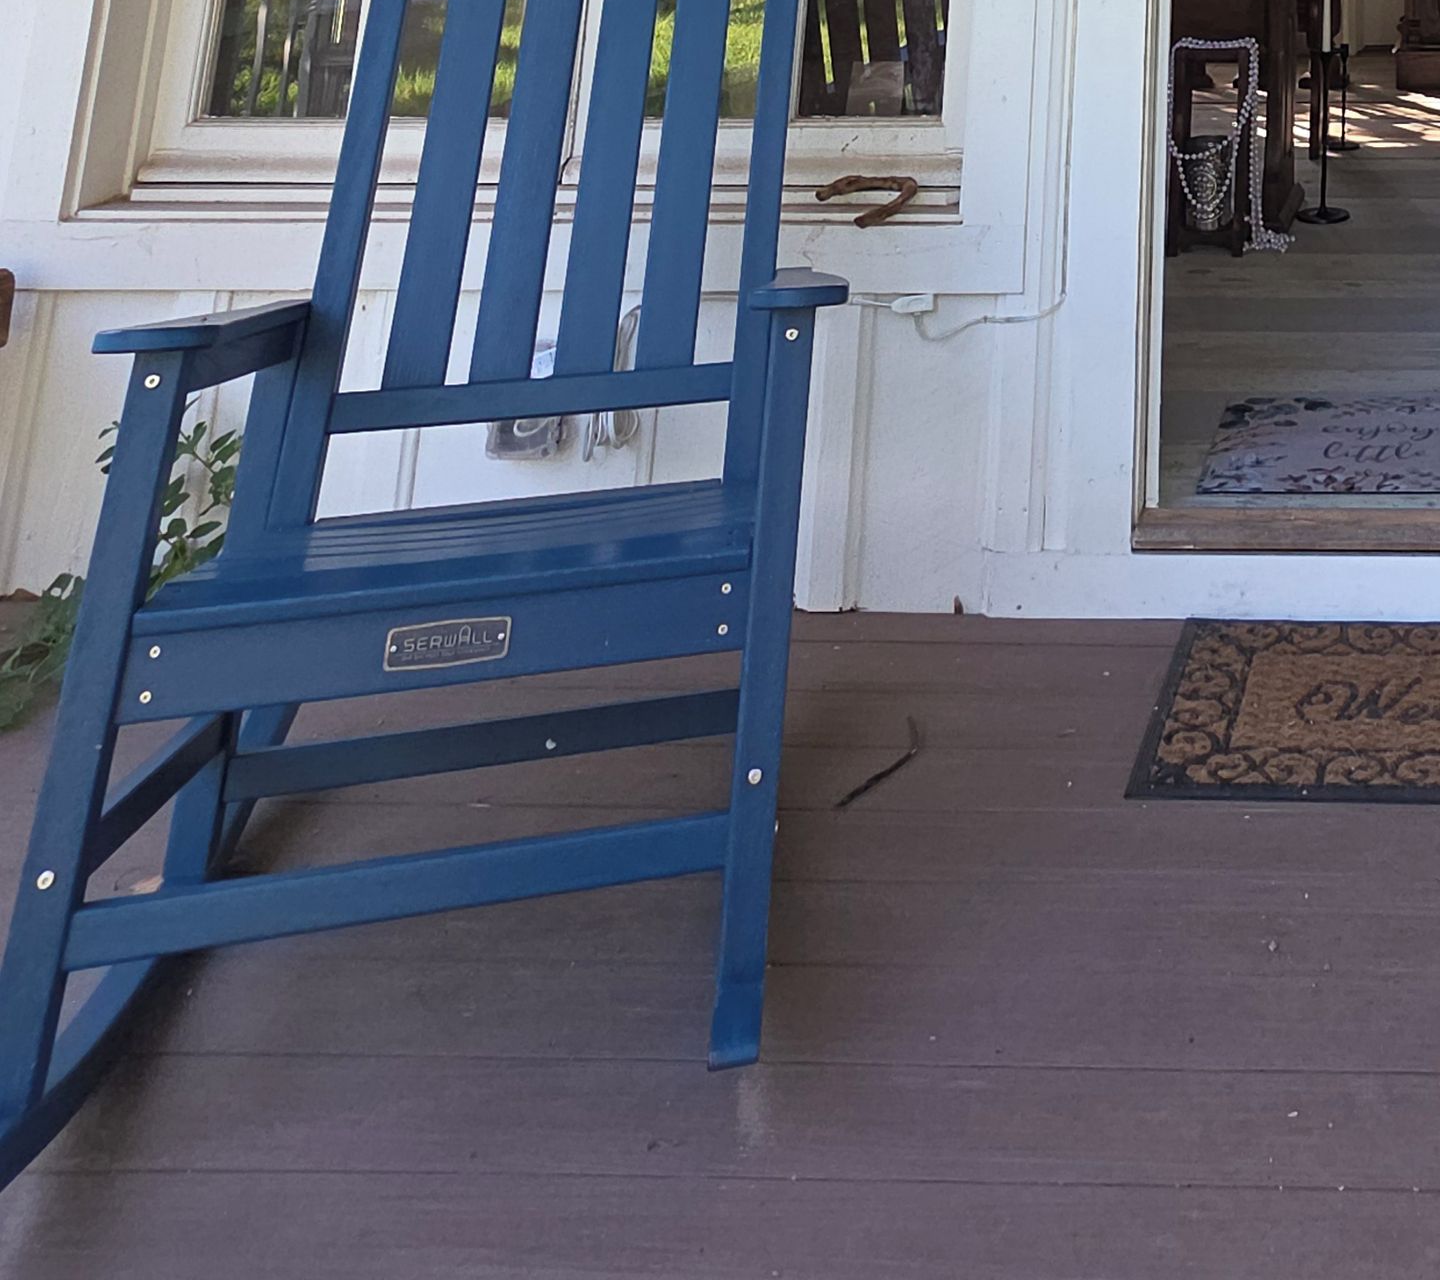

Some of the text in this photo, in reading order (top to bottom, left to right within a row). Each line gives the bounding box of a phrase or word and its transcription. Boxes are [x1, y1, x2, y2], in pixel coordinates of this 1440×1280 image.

[1322, 421, 1436, 441] enjoy
[1323, 441, 1424, 463] little
[403, 624, 492, 653] SERWALL
